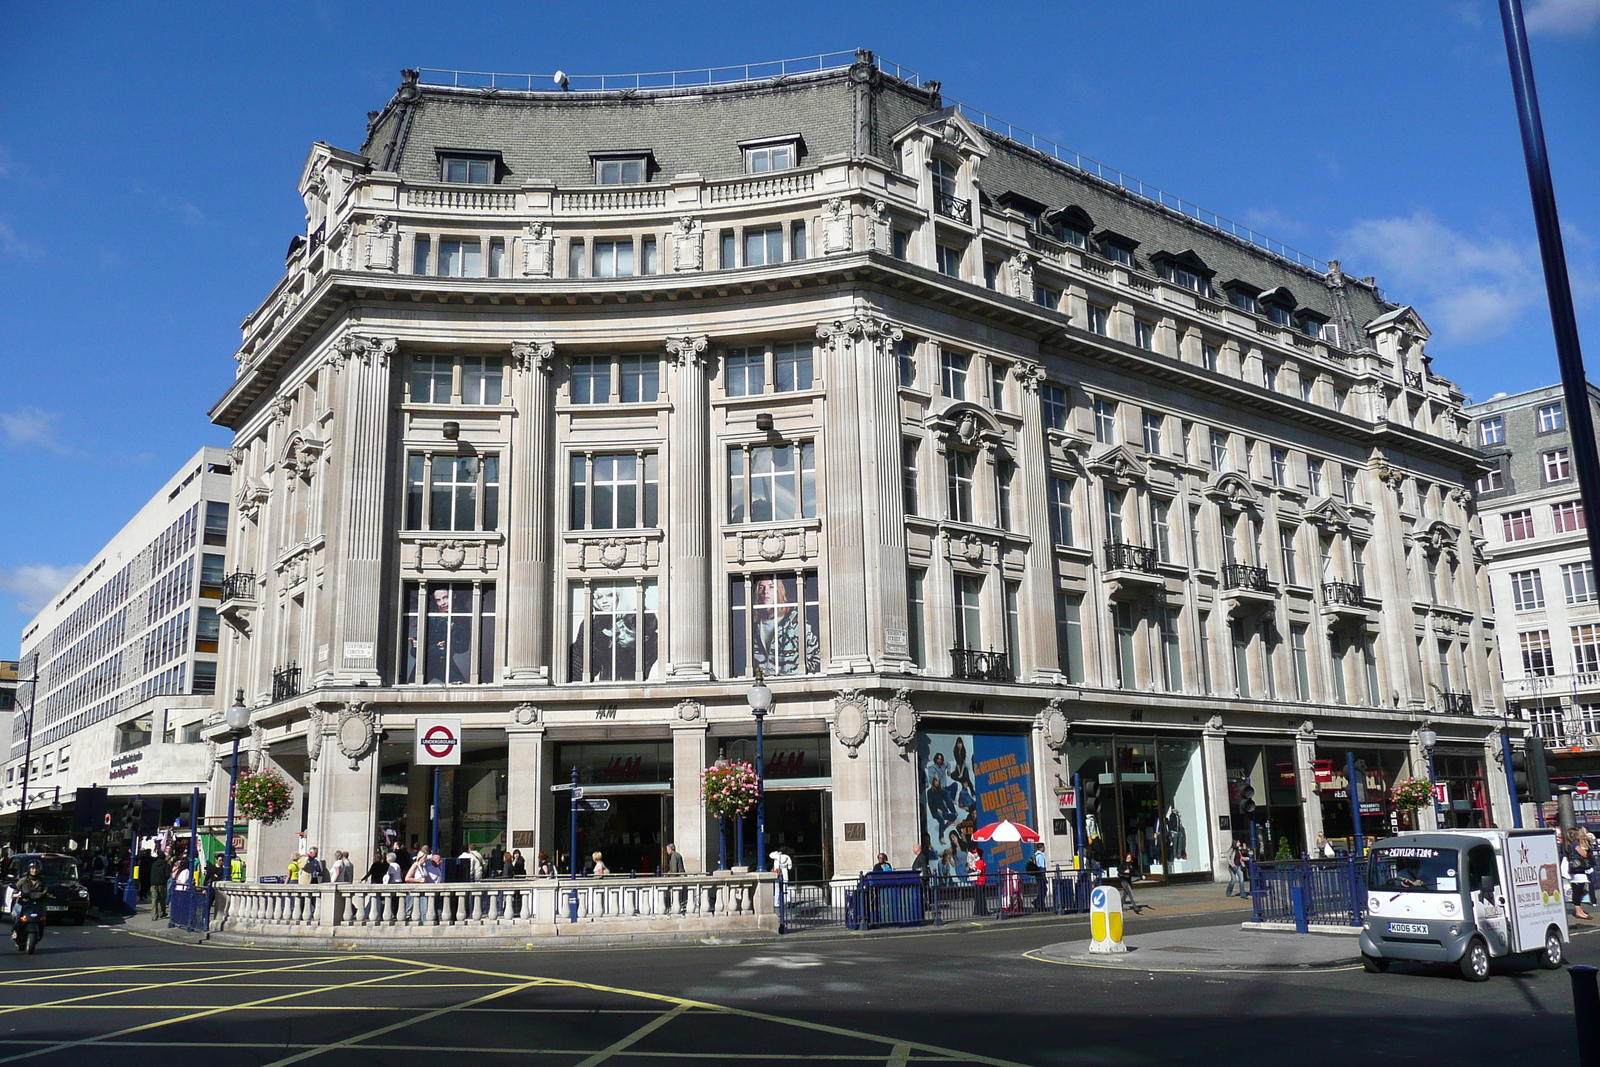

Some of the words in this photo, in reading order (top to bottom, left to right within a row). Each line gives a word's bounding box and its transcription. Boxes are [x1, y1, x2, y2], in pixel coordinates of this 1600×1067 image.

[980, 758, 1000, 774] DENIM
[1000, 753, 1017, 769] DAYS
[988, 768, 1008, 785] JEANS
[1008, 764, 1021, 779] FOR
[980, 787, 1008, 813] HOLD
[1059, 793, 1075, 806] H&M
[1514, 865, 1538, 883] DELIVERS
[1412, 924, 1427, 934] SKX
